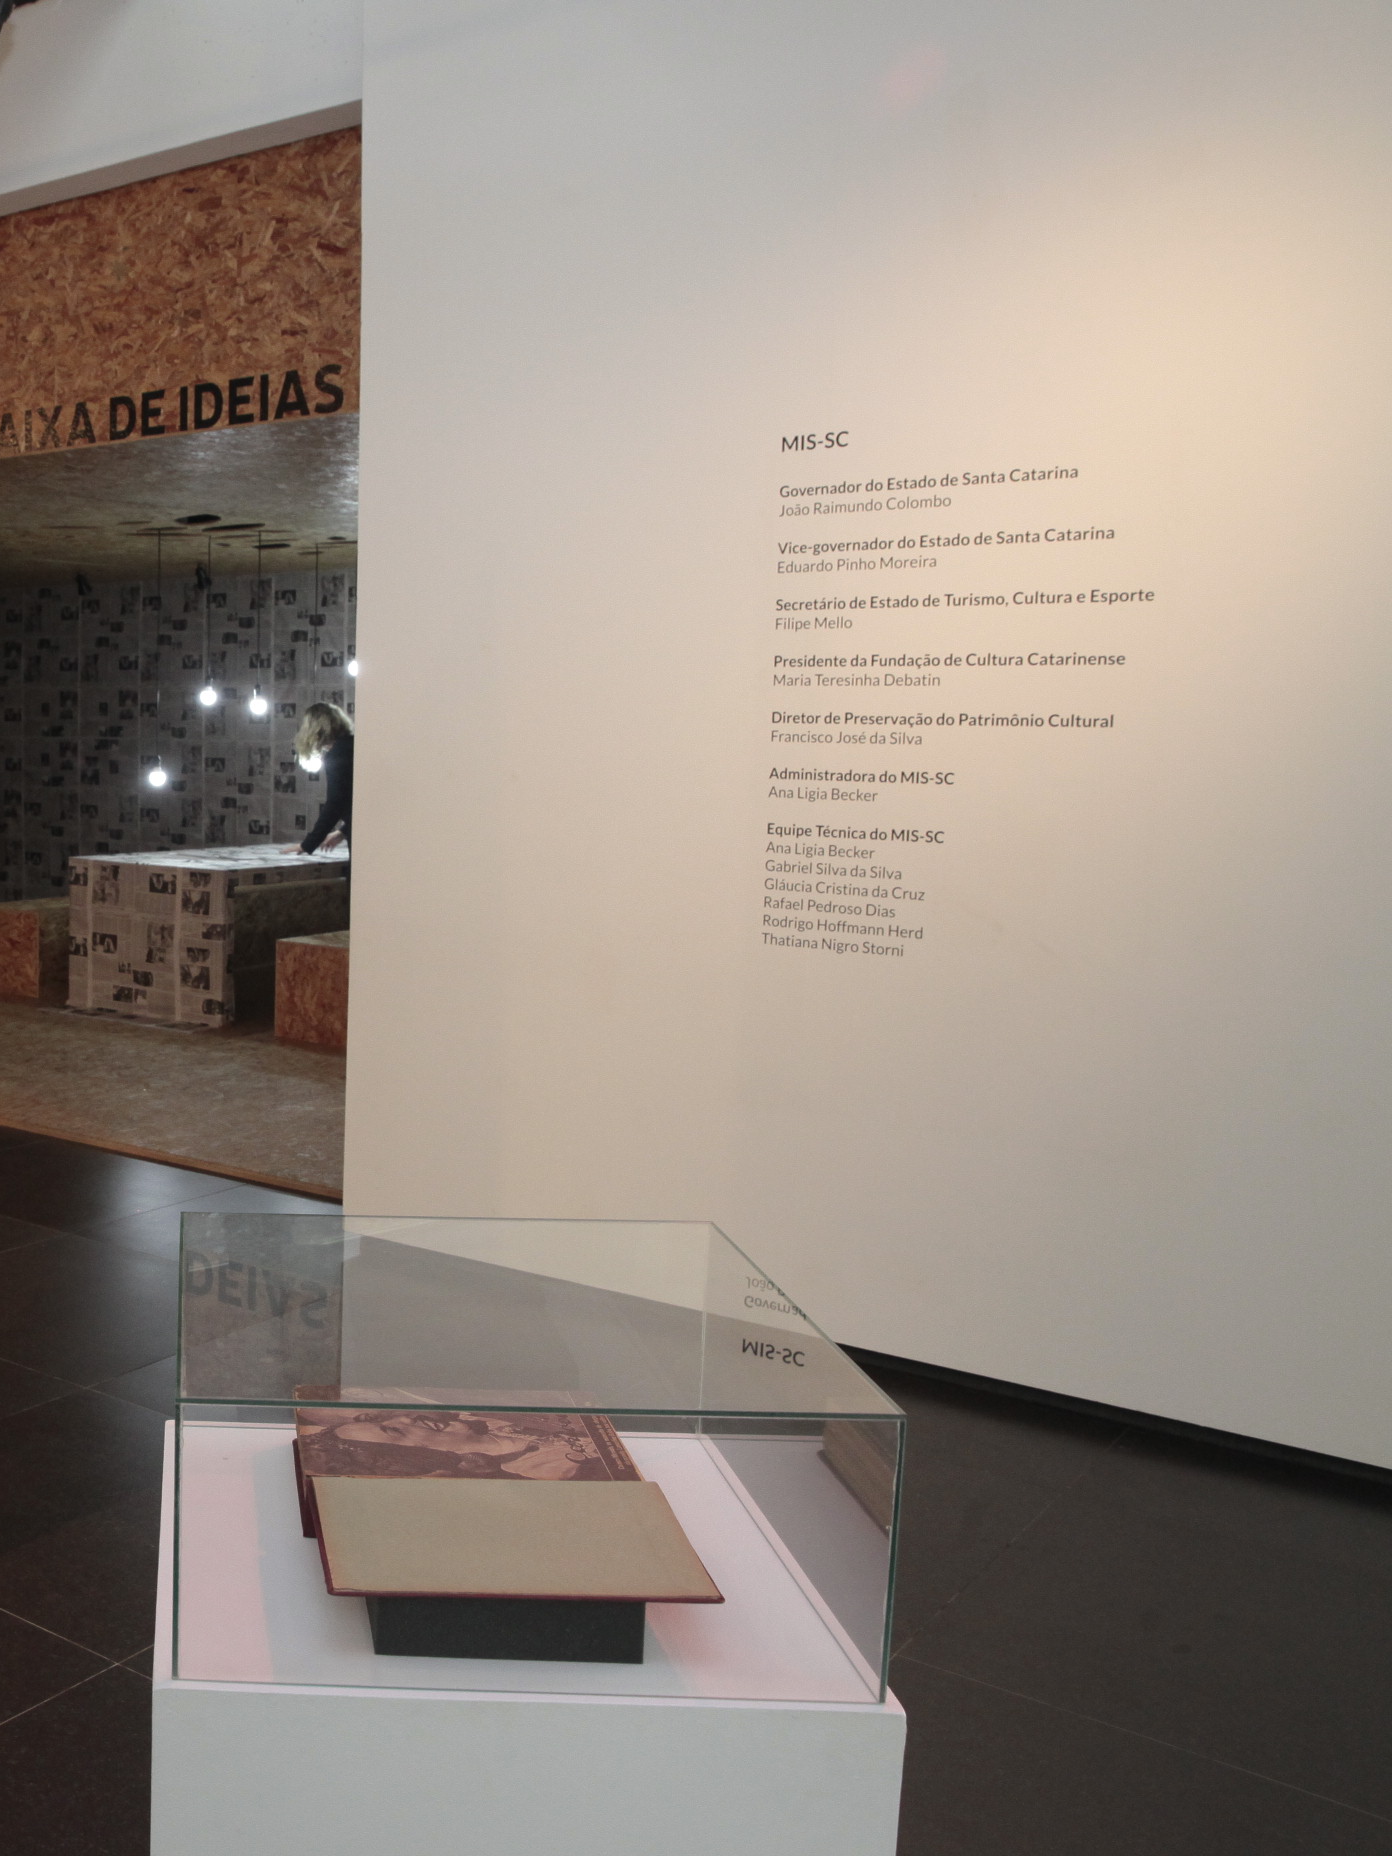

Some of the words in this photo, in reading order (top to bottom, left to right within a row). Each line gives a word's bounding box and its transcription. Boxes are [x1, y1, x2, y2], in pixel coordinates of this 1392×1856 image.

[110, 389, 166, 440] DE
[179, 365, 344, 431] IDEIAS
[782, 431, 848, 452] MIS-SC
[779, 481, 860, 498] Governador
[865, 479, 883, 492] do
[888, 475, 936, 490] Estado
[940, 474, 958, 487] de
[963, 472, 1005, 485] Santa
[1010, 466, 1078, 482] Catarina
[779, 504, 809, 517] João
[814, 499, 882, 514] Raimundo
[886, 495, 951, 510] Colombo
[778, 538, 894, 555] Vice-governador
[898, 536, 915, 548] do
[920, 533, 970, 547] Estado
[974, 532, 992, 545] de
[997, 531, 1040, 544] Santa
[1045, 527, 1114, 542] Catarina
[778, 560, 833, 573] Eduardo
[837, 558, 876, 570] Pinho
[880, 557, 936, 569] Moreira
[776, 597, 846, 611] Secretário
[849, 597, 866, 609] de
[870, 595, 918, 608] Estado
[923, 594, 940, 607] de
[944, 593, 1008, 606] Turismo,
[1013, 591, 1072, 605] Cultura
[1077, 593, 1085, 603] e
[1091, 589, 1154, 605] Esporte
[776, 618, 810, 632] Filipe
[815, 616, 852, 629] Mello
[774, 655, 847, 667] Presidente
[851, 654, 866, 667] da
[871, 654, 940, 669] Fundação
[944, 654, 962, 666] de
[966, 653, 1023, 666] Cultura
[1028, 652, 1125, 665] Catarinense
[774, 674, 811, 686] Maria
[815, 674, 879, 686] Teresinha
[884, 674, 940, 686] Debatin
[772, 712, 821, 724] Diretor
[824, 712, 840, 724] de
[845, 712, 932, 727] Preservação
[936, 713, 954, 725] do
[959, 713, 1044, 727] Patrimônio
[1048, 714, 1114, 727] Cultural
[771, 730, 832, 743] Francisco
[836, 732, 866, 744] José
[870, 732, 885, 744] da
[890, 732, 922, 745] Silva
[769, 768, 875, 782] Administradora
[879, 771, 896, 783] do
[901, 771, 954, 785] MIS-SC
[768, 786, 793, 798] Ana
[798, 787, 827, 802] Ligia
[831, 788, 878, 802] Becker
[767, 823, 812, 838] Equipe
[816, 825, 866, 839] Técnica
[870, 828, 887, 840] do
[891, 829, 944, 843] MIS-SC
[766, 842, 791, 853] Ana
[795, 843, 824, 858] Ligia
[829, 845, 875, 859] Becker
[765, 860, 812, 874] Gabriel
[816, 863, 846, 876] Silva
[850, 865, 866, 877] da
[870, 866, 901, 880] Silva
[765, 878, 812, 892] Gláucia
[816, 882, 868, 896] Cristina
[872, 886, 887, 898] da
[892, 887, 925, 901] Cruz
[764, 896, 803, 910] Rafael
[808, 900, 862, 915] Pedroso
[866, 904, 895, 918] Dias
[763, 915, 813, 932] Rodrigo
[817, 919, 884, 935] Hoffmann
[889, 925, 923, 939] Herd
[762, 933, 817, 948] Thatiana
[822, 938, 858, 954] Nigro
[863, 942, 903, 956] Storni
